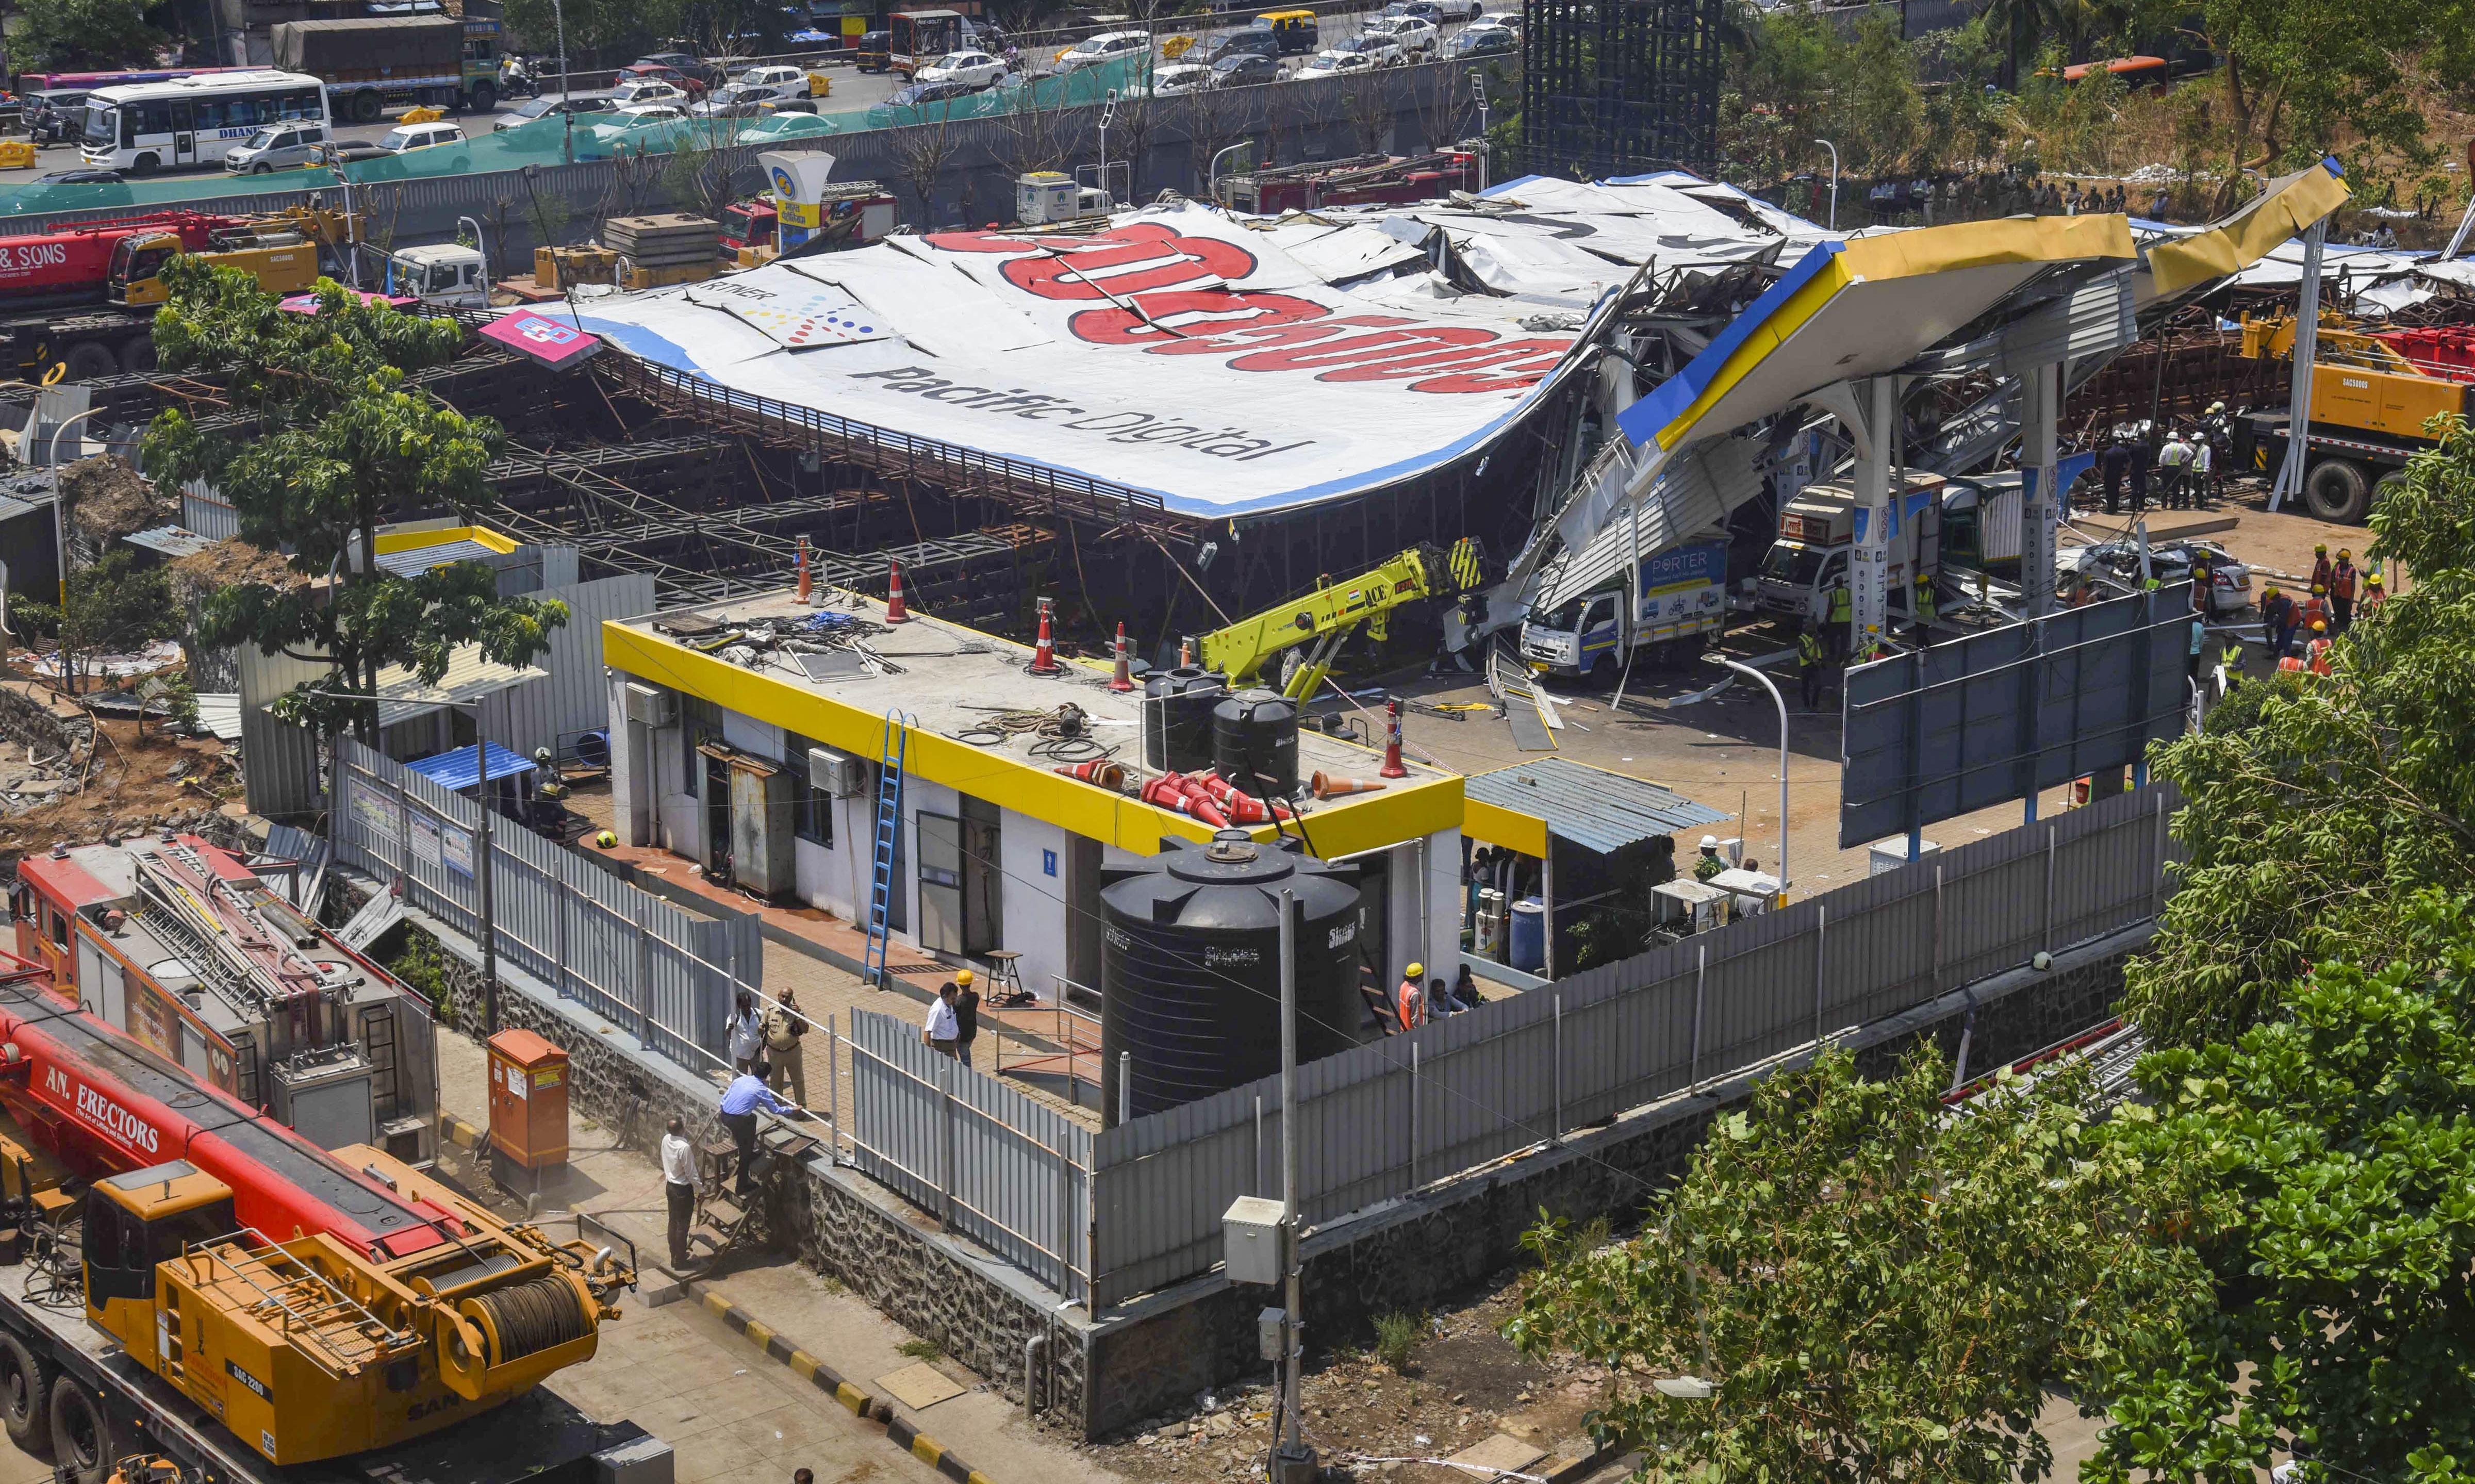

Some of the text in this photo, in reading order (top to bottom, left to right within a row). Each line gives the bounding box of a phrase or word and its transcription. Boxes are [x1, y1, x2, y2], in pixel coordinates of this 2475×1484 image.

[0, 243, 66, 268] & SONS
[697, 282, 778, 300] RTNER
[2342, 378, 2368, 389] SAC5000S
[846, 366, 1317, 461] Pacific Digital
[1653, 552, 1708, 574] PORTER
[1364, 584, 1387, 607] ACE
[76, 1083, 158, 1153] ERECTORS
[234, 1365, 246, 1383] SAC
[248, 1378, 263, 1395] 2200
